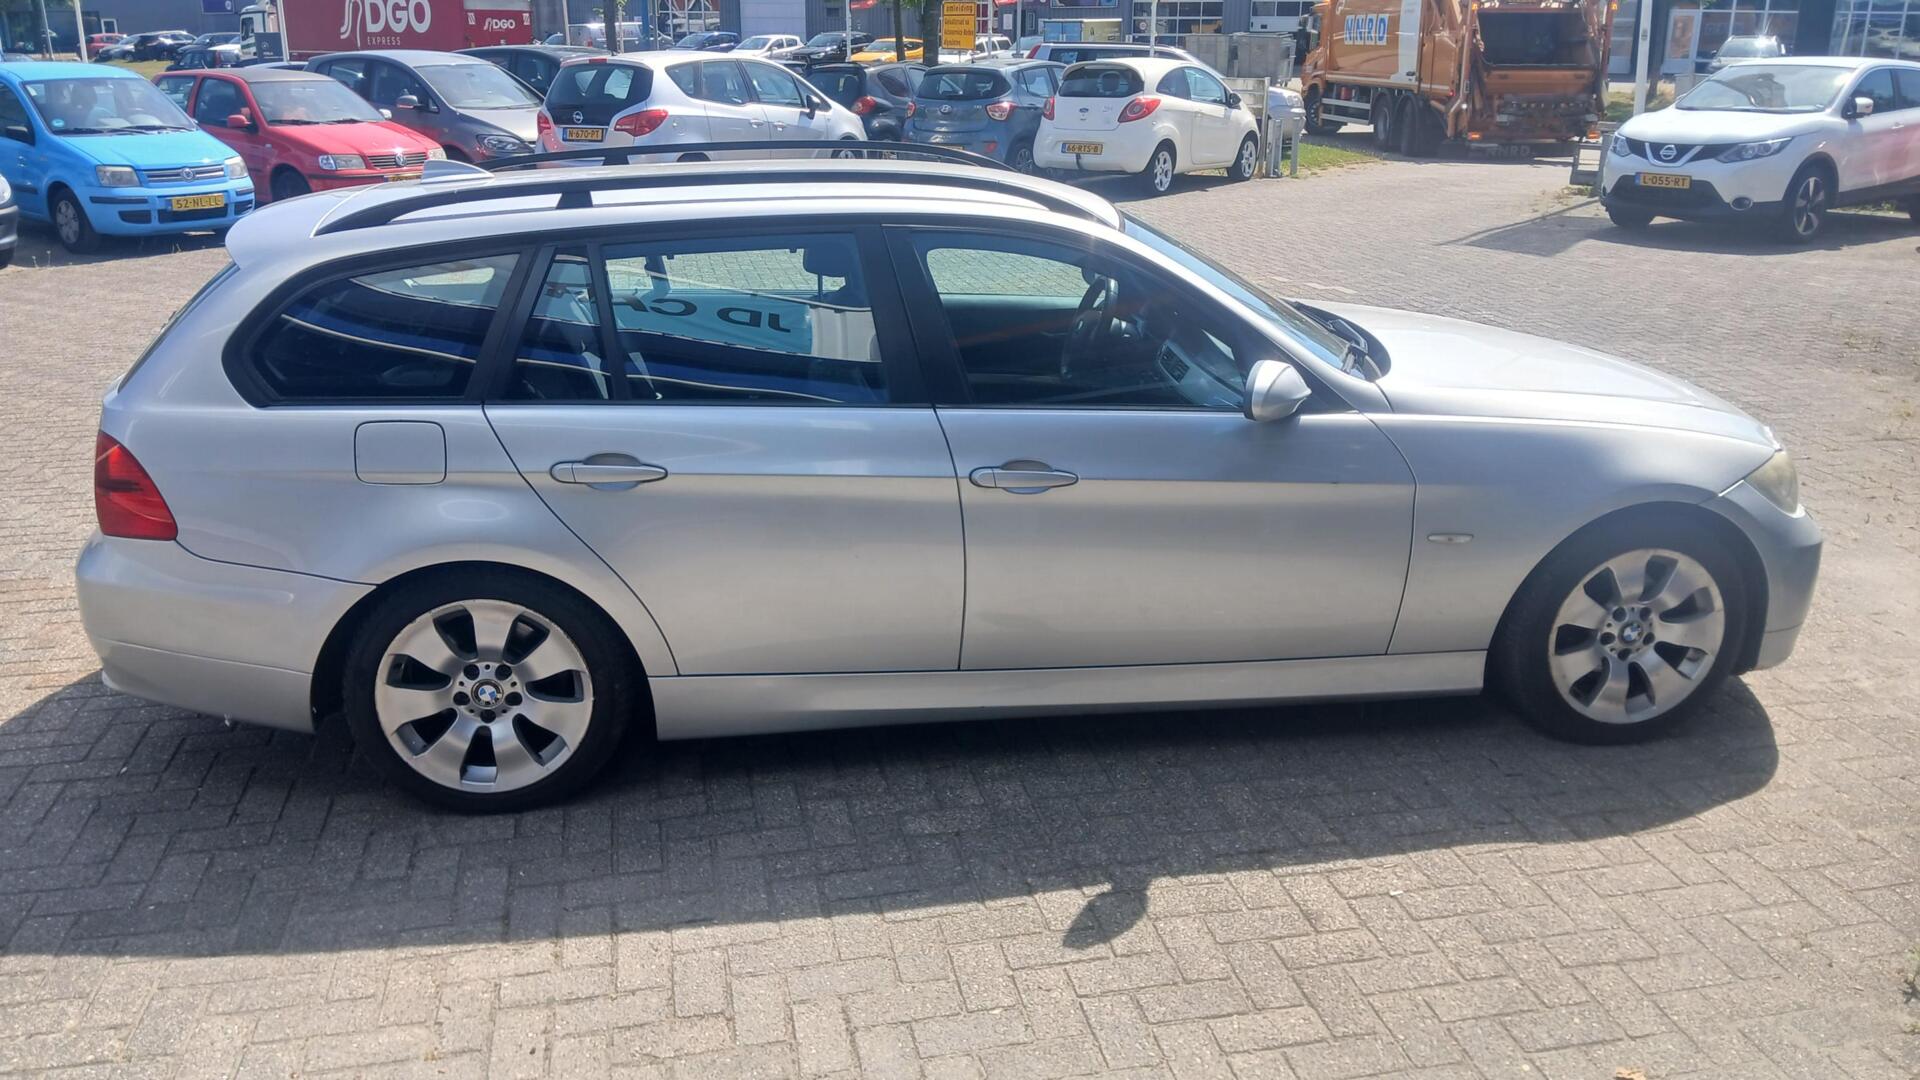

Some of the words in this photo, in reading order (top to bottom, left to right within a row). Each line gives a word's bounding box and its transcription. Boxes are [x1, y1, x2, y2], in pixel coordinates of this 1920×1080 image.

[365, 0, 431, 33] DGO
[492, 18, 516, 29] DGO
[367, 36, 401, 46] EXPRESS
[1642, 175, 1688, 187] L-055-RT
[176, 194, 221, 209] 52-NL-LL
